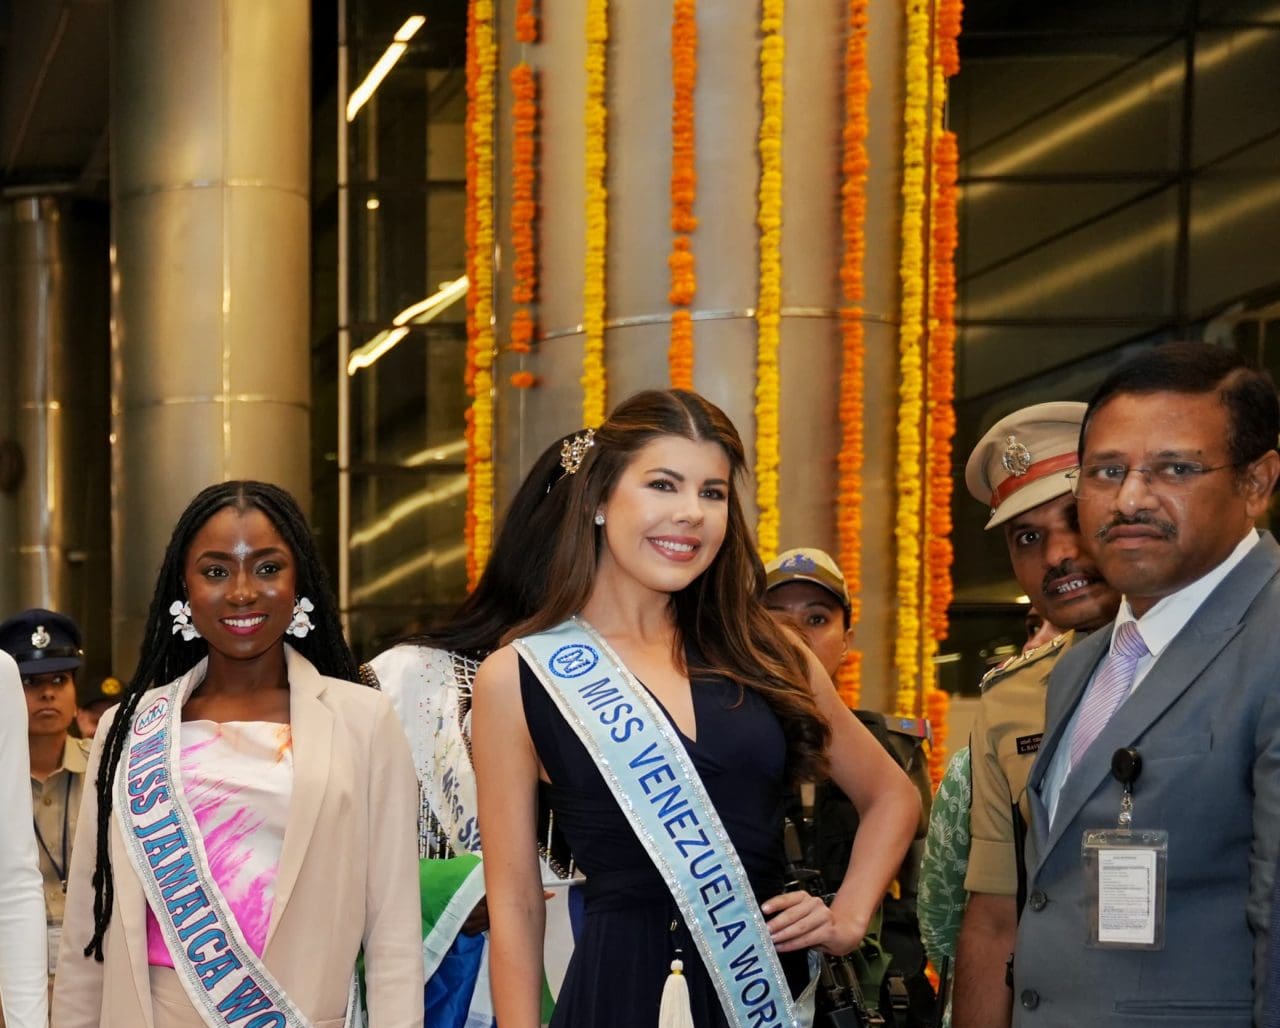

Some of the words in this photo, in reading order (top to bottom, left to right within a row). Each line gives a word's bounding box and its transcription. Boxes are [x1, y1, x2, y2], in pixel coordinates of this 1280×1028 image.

[128, 728, 169, 816] MISS
[578, 677, 644, 743] MISS
[628, 742, 746, 949] VENEZUELA
[133, 809, 243, 992] JAMAICA
